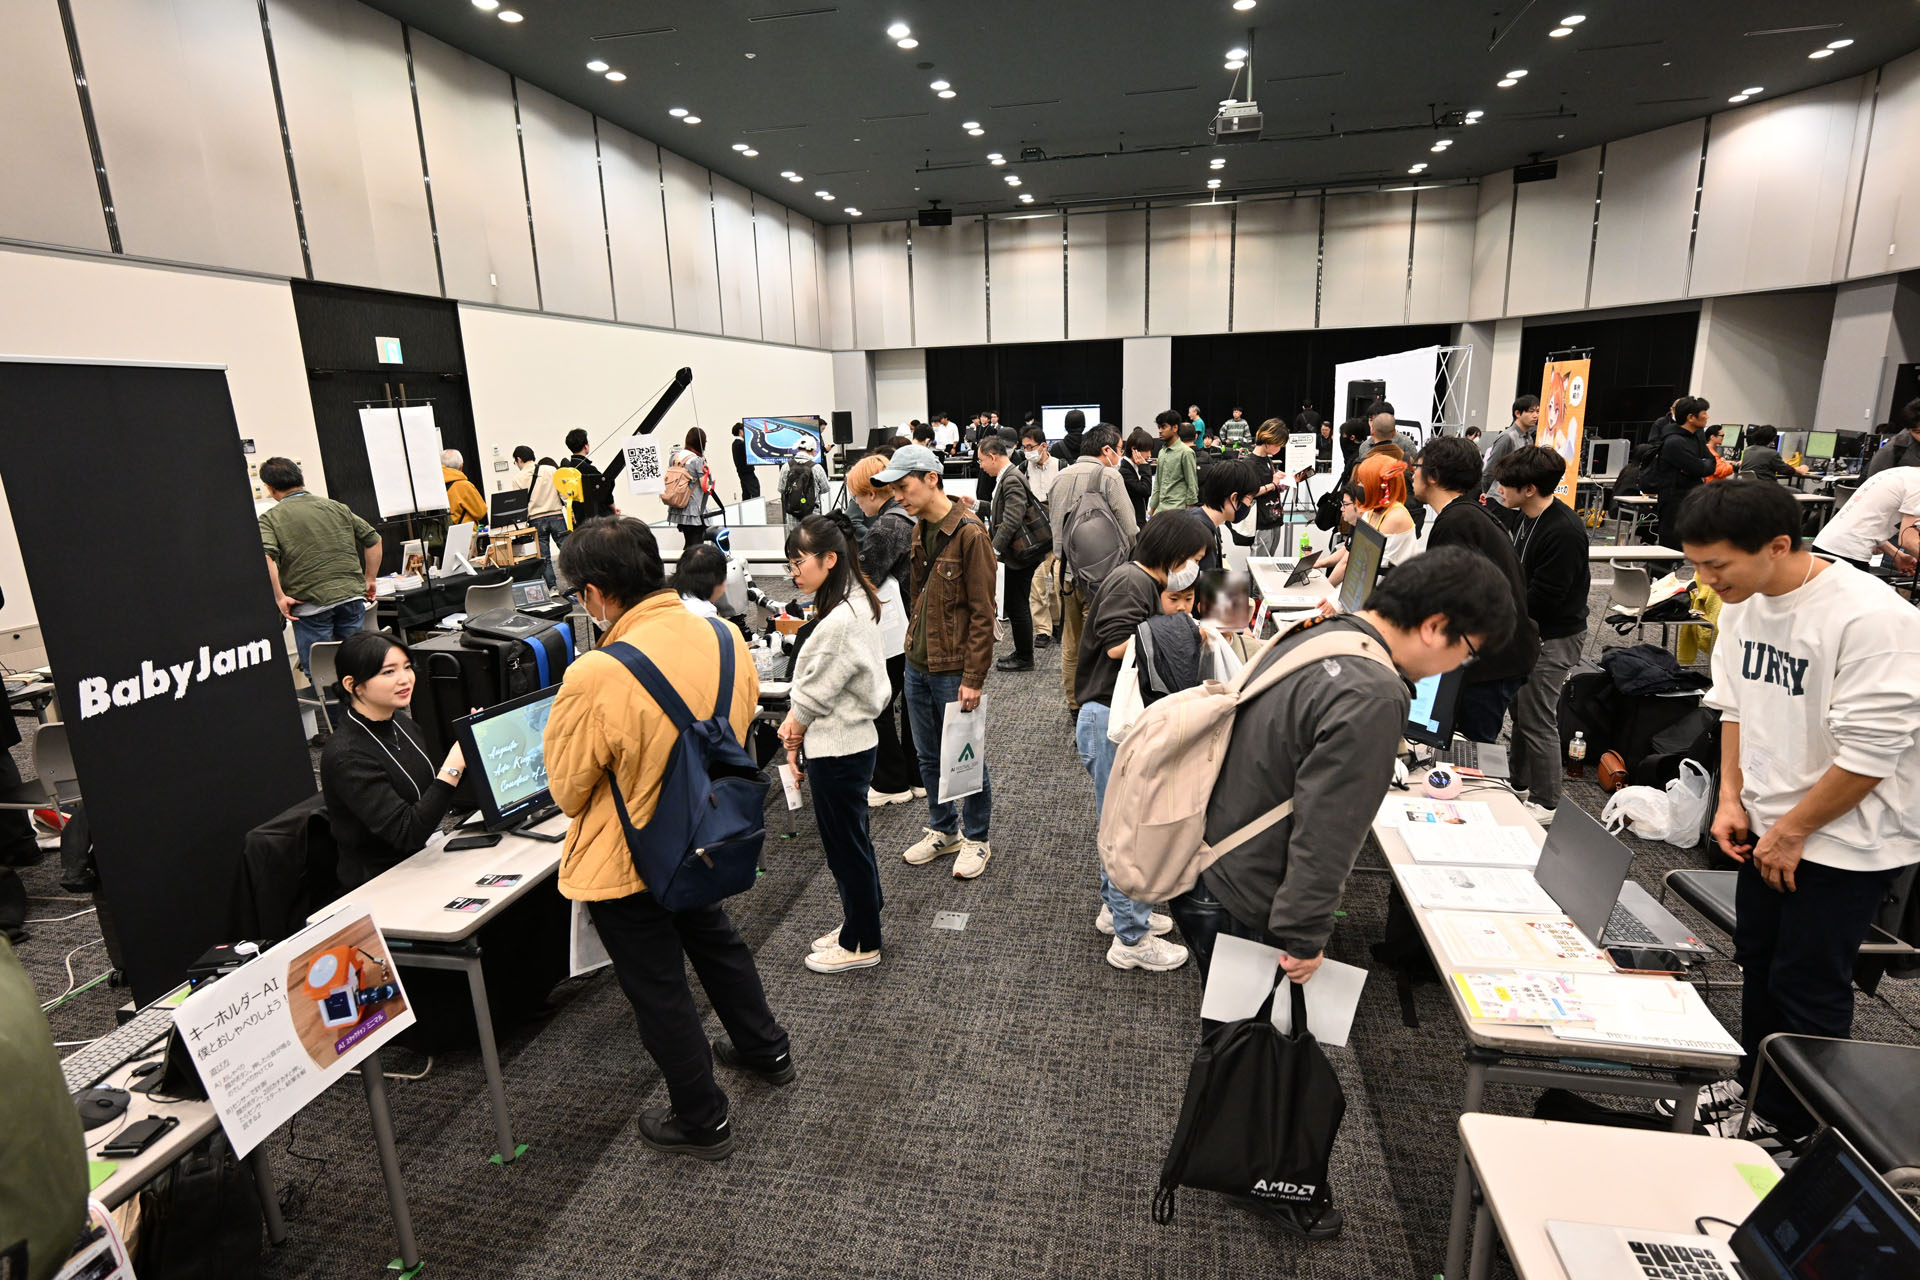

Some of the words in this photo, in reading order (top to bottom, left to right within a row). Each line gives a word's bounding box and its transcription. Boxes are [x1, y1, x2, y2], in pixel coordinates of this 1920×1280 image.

[79, 638, 272, 720] BabyJam
[189, 977, 280, 1041] キーホルダーAI
[1254, 1179, 1298, 1193] AMD
